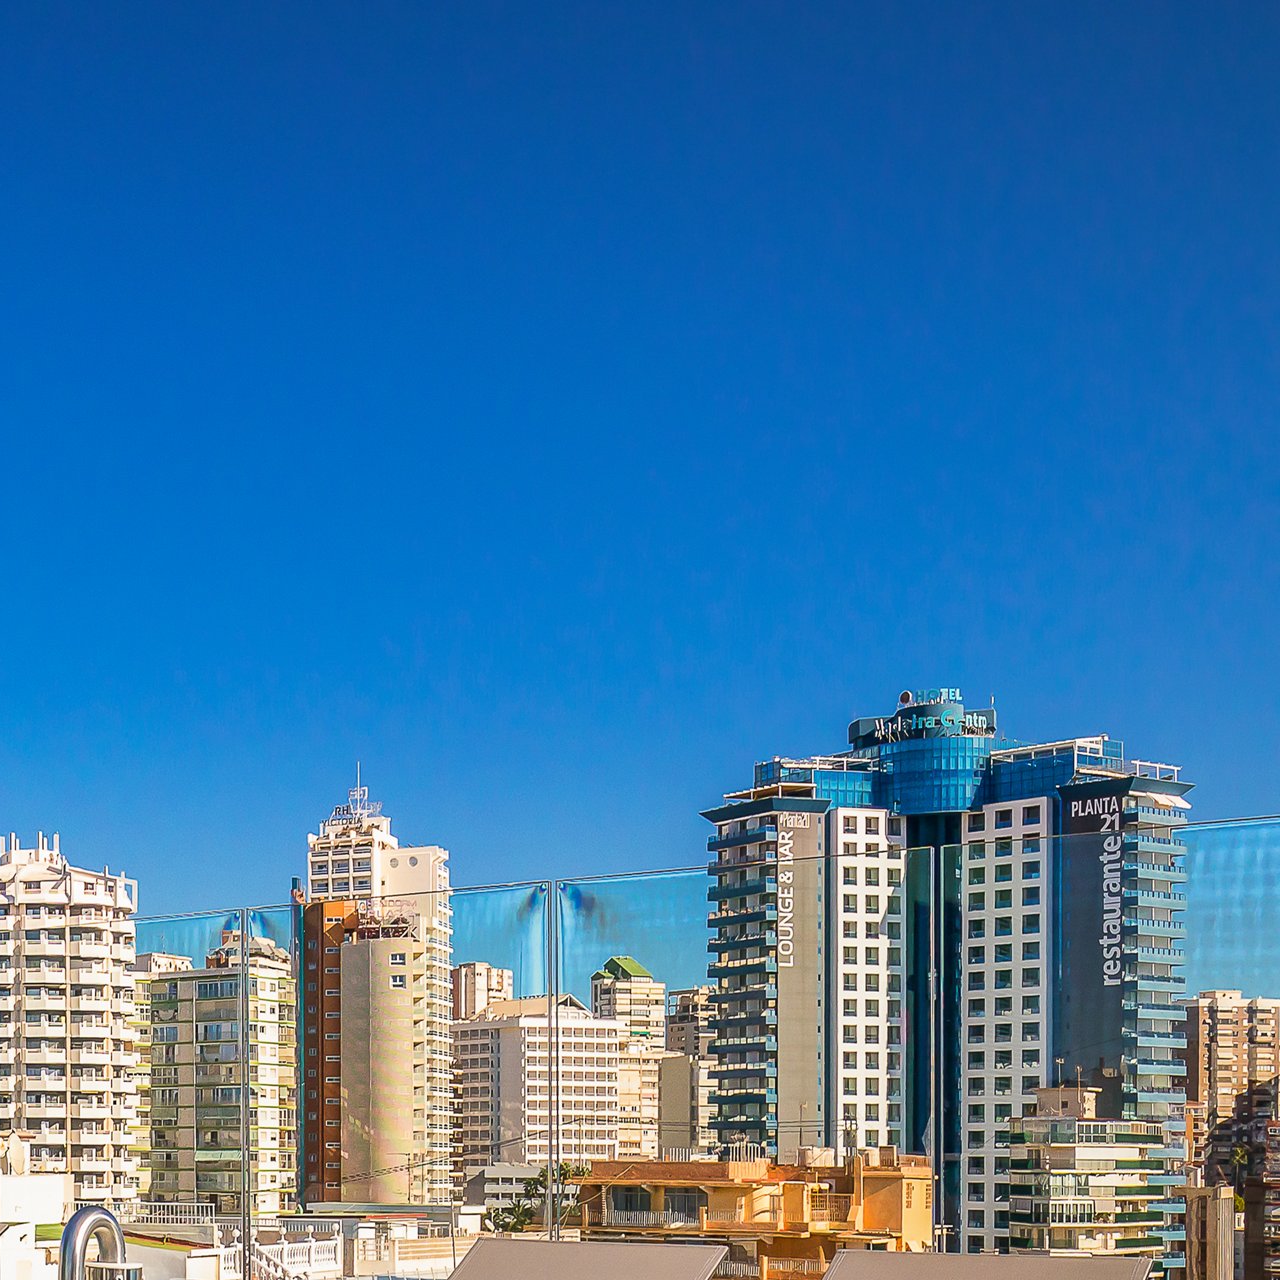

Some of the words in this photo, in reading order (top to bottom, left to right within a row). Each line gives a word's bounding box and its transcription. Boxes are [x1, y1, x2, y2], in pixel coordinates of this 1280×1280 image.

[915, 688, 963, 702] HOTEL
[334, 805, 350, 816] RH
[1071, 796, 1119, 817] PLANTA
[320, 817, 363, 827] VICTORIA
[1100, 812, 1120, 834] 21
[778, 830, 794, 865] BAR
[778, 870, 794, 884] &
[1099, 835, 1122, 986] restaurante
[778, 886, 794, 968] LOUNGE
